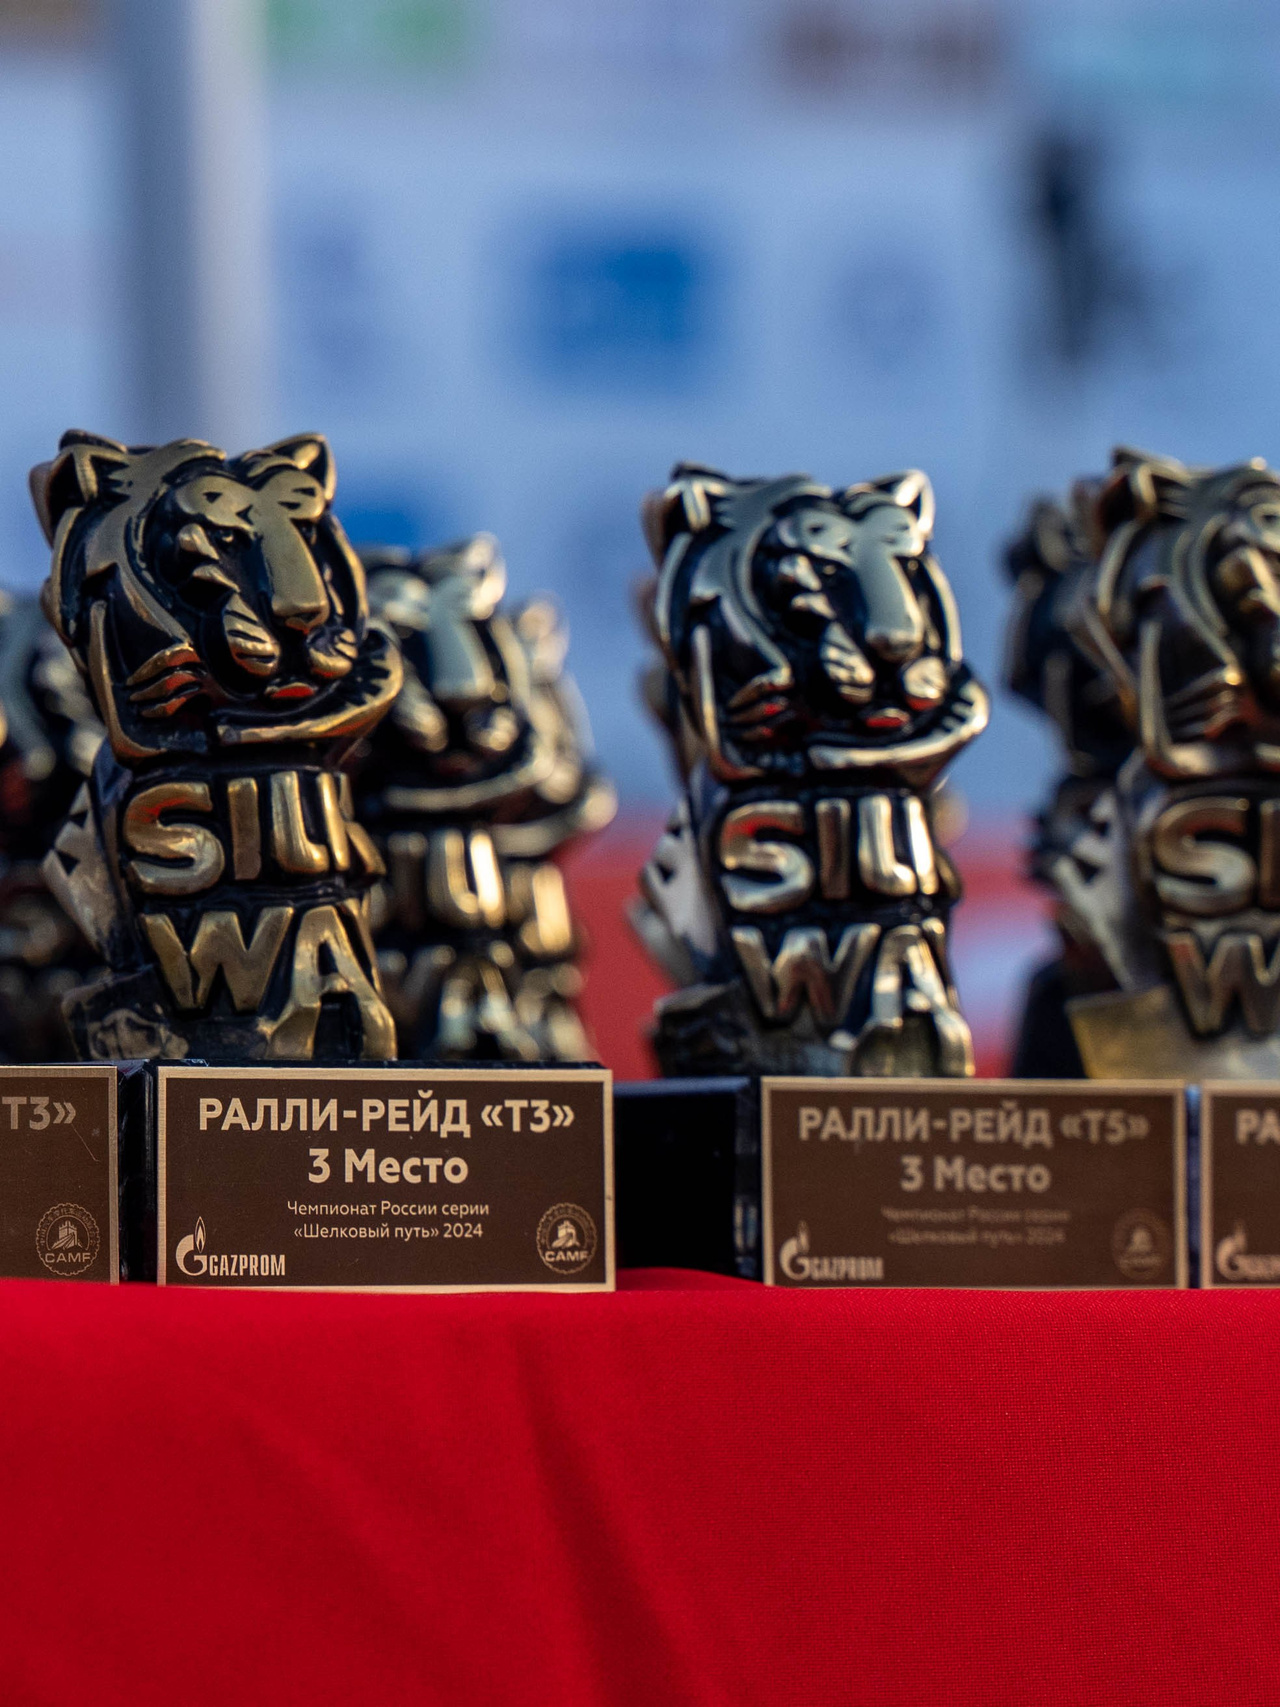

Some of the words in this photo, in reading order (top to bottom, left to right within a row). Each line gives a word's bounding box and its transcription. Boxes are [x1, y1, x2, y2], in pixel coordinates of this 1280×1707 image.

[200, 1090, 470, 1138] РАЛЛИ-РЕЙД
[481, 1100, 574, 1132] «Т3»
[800, 1101, 1052, 1148] РАЛЛИ-РЕЙД
[309, 1148, 330, 1183] 3
[345, 1149, 468, 1183] Место
[901, 1156, 923, 1191] 3
[934, 1156, 1050, 1192] Место
[288, 1201, 376, 1215] Чемпионат
[381, 1201, 437, 1215] России
[442, 1204, 489, 1219] серии
[294, 1223, 389, 1238] «Шелковый
[395, 1227, 439, 1241] путь»
[444, 1223, 483, 1238] 2024
[45, 1252, 91, 1263] CAMF
[209, 1255, 285, 1276] GAZPROM
[544, 1250, 588, 1262] CAMF
